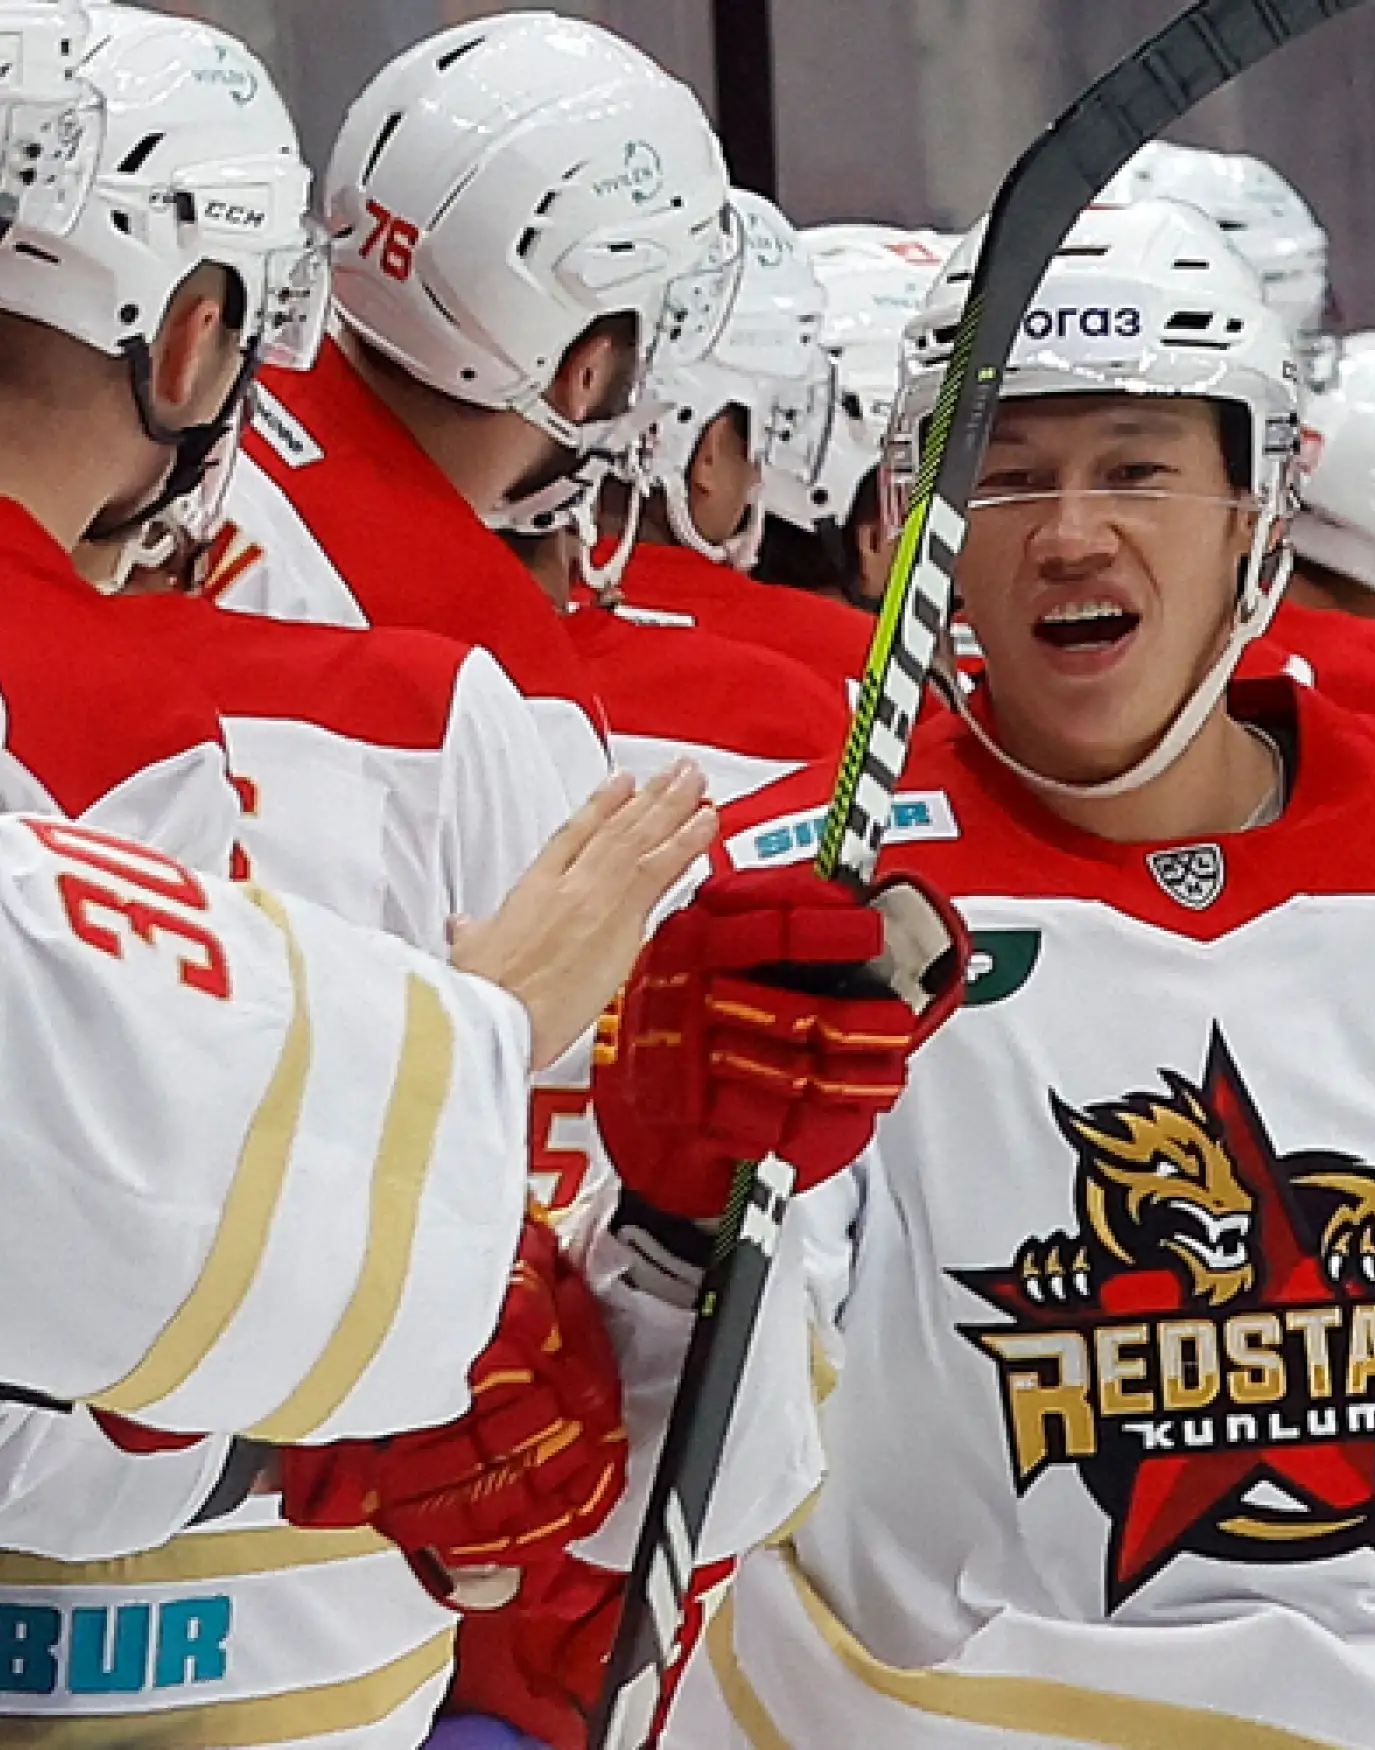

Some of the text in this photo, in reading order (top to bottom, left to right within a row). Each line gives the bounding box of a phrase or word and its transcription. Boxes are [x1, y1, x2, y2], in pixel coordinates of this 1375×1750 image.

[205, 201, 265, 228] CCM
[358, 198, 420, 282] 76
[1021, 307, 1141, 338] огаз
[20, 817, 234, 1002] 30
